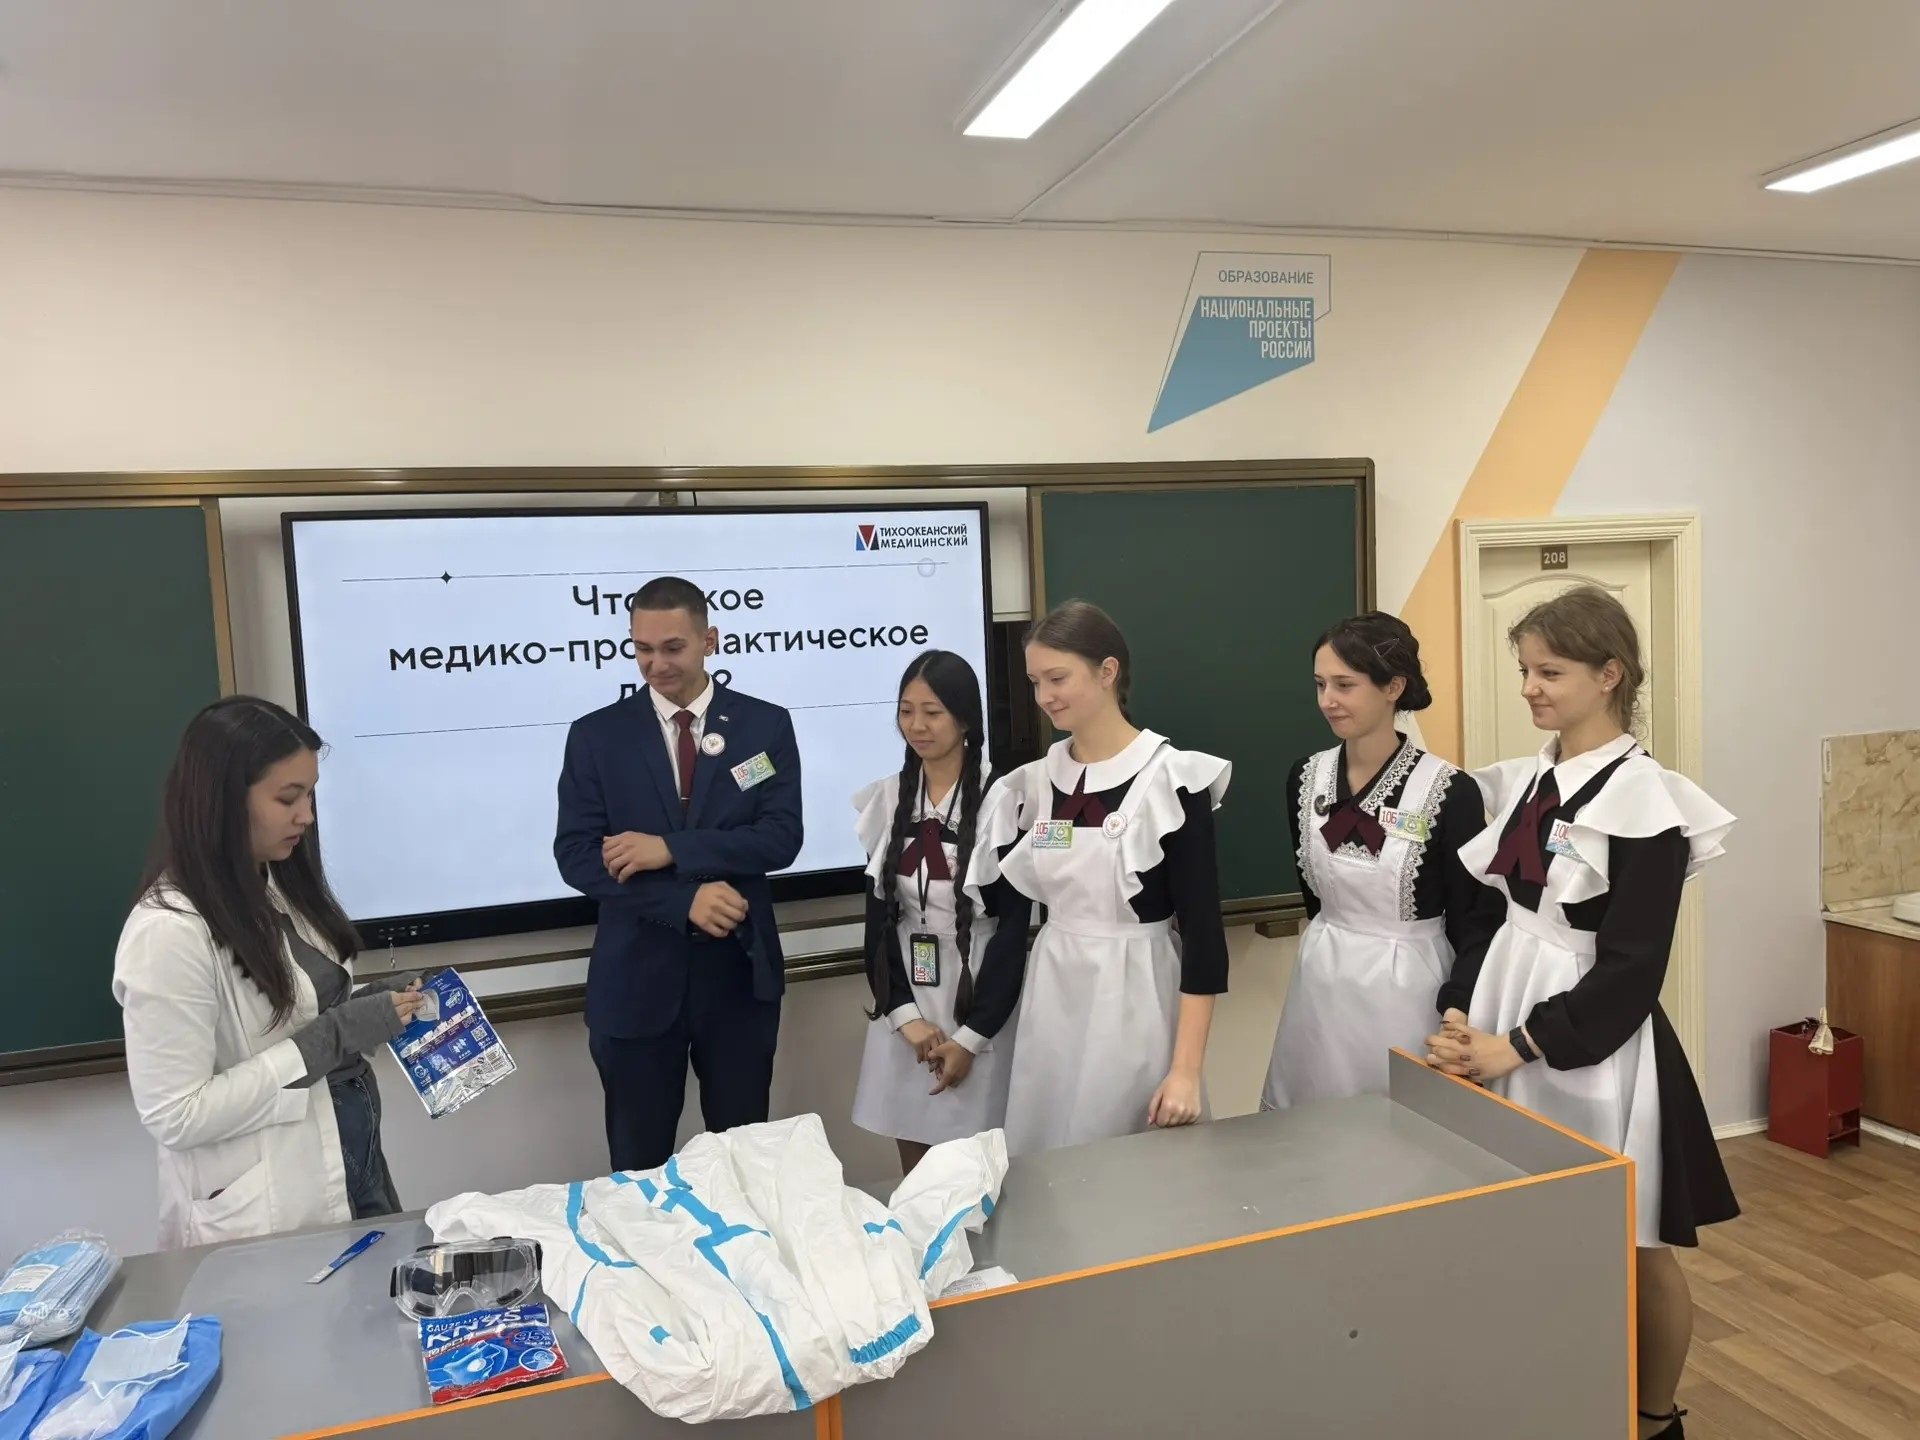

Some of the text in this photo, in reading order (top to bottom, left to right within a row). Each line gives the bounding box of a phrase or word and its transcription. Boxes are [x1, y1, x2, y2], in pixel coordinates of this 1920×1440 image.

[1218, 270, 1314, 284] ОБРАЗОВАНИЕ
[1200, 299, 1311, 319] НАЦИОНАЛЬНЫЕ
[1249, 320, 1311, 338] ПРОЕКТЫ
[1261, 341, 1312, 358] РОССИИ
[880, 523, 967, 537] ТИХООКЕАНСКИЙ
[880, 535, 968, 549] МЕДИЦИНСКИЙ
[1543, 552, 1566, 564] 208
